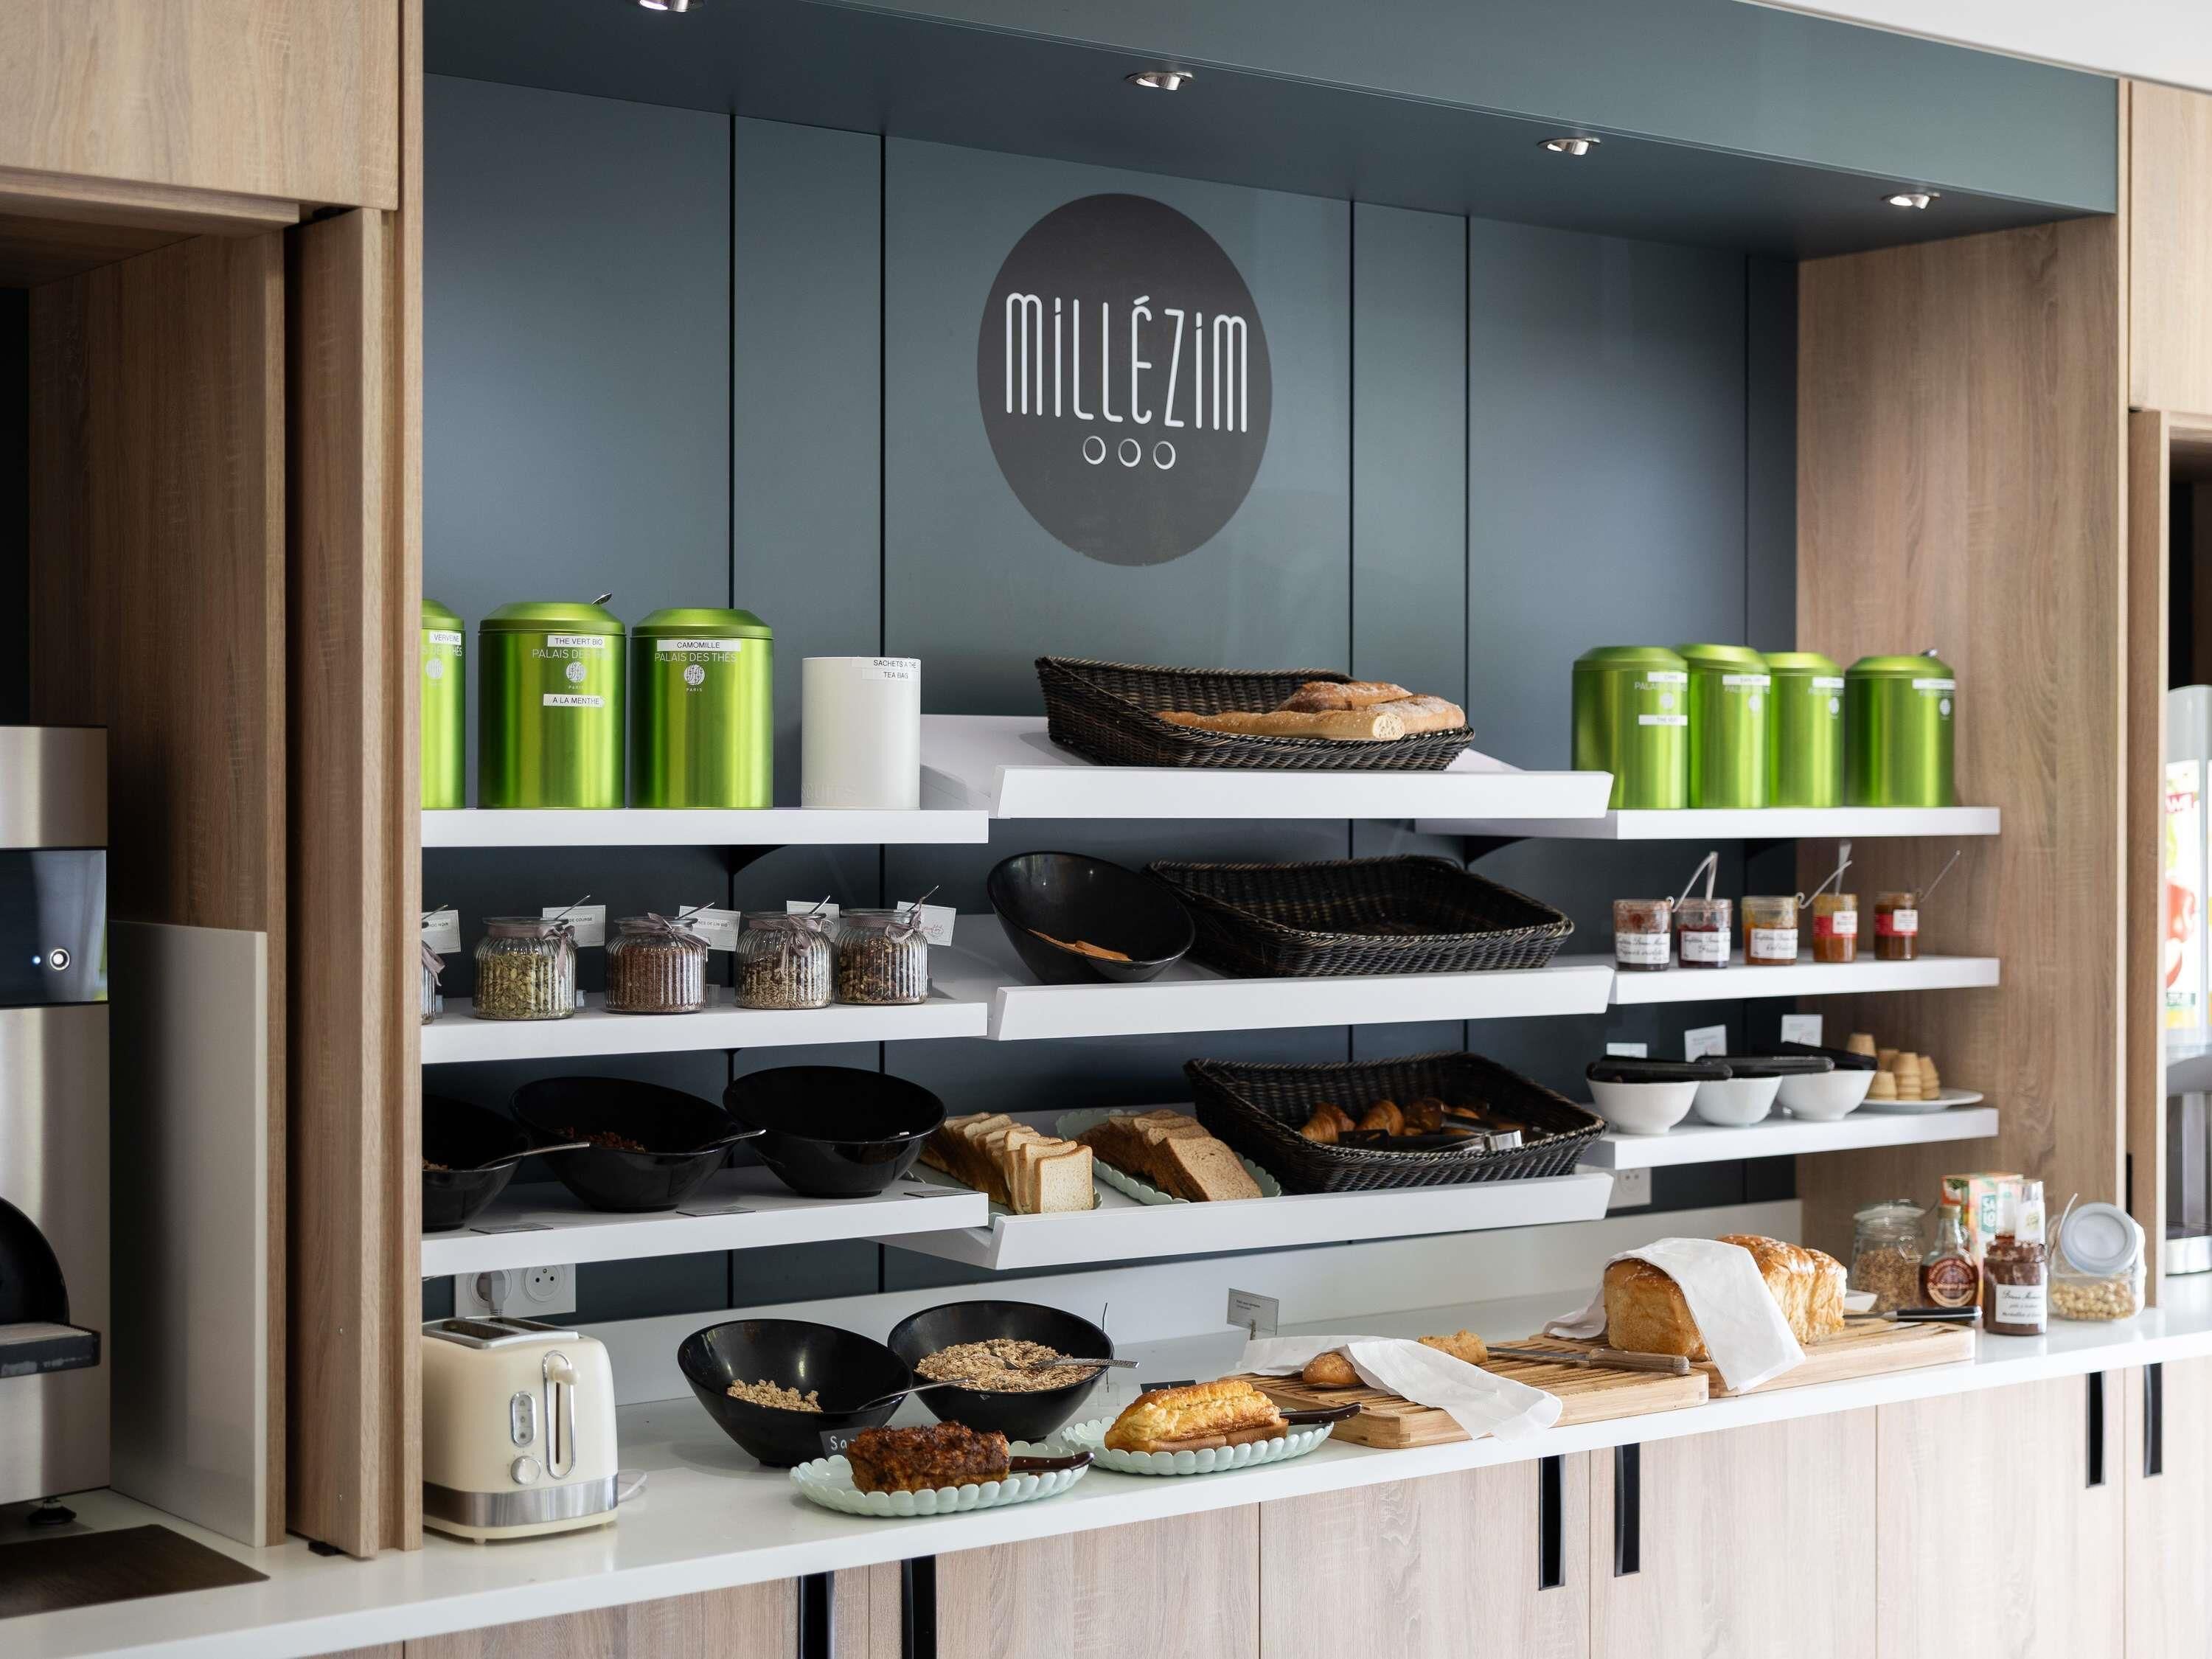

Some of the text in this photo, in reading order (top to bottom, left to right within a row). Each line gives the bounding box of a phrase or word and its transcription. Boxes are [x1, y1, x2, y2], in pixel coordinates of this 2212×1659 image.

[434, 633, 460, 643] VERVEINE
[532, 649, 569, 659] PALAIS
[654, 653, 687, 662] PALAIS
[689, 653, 709, 662] DES
[873, 659, 903, 667] SACHETS
